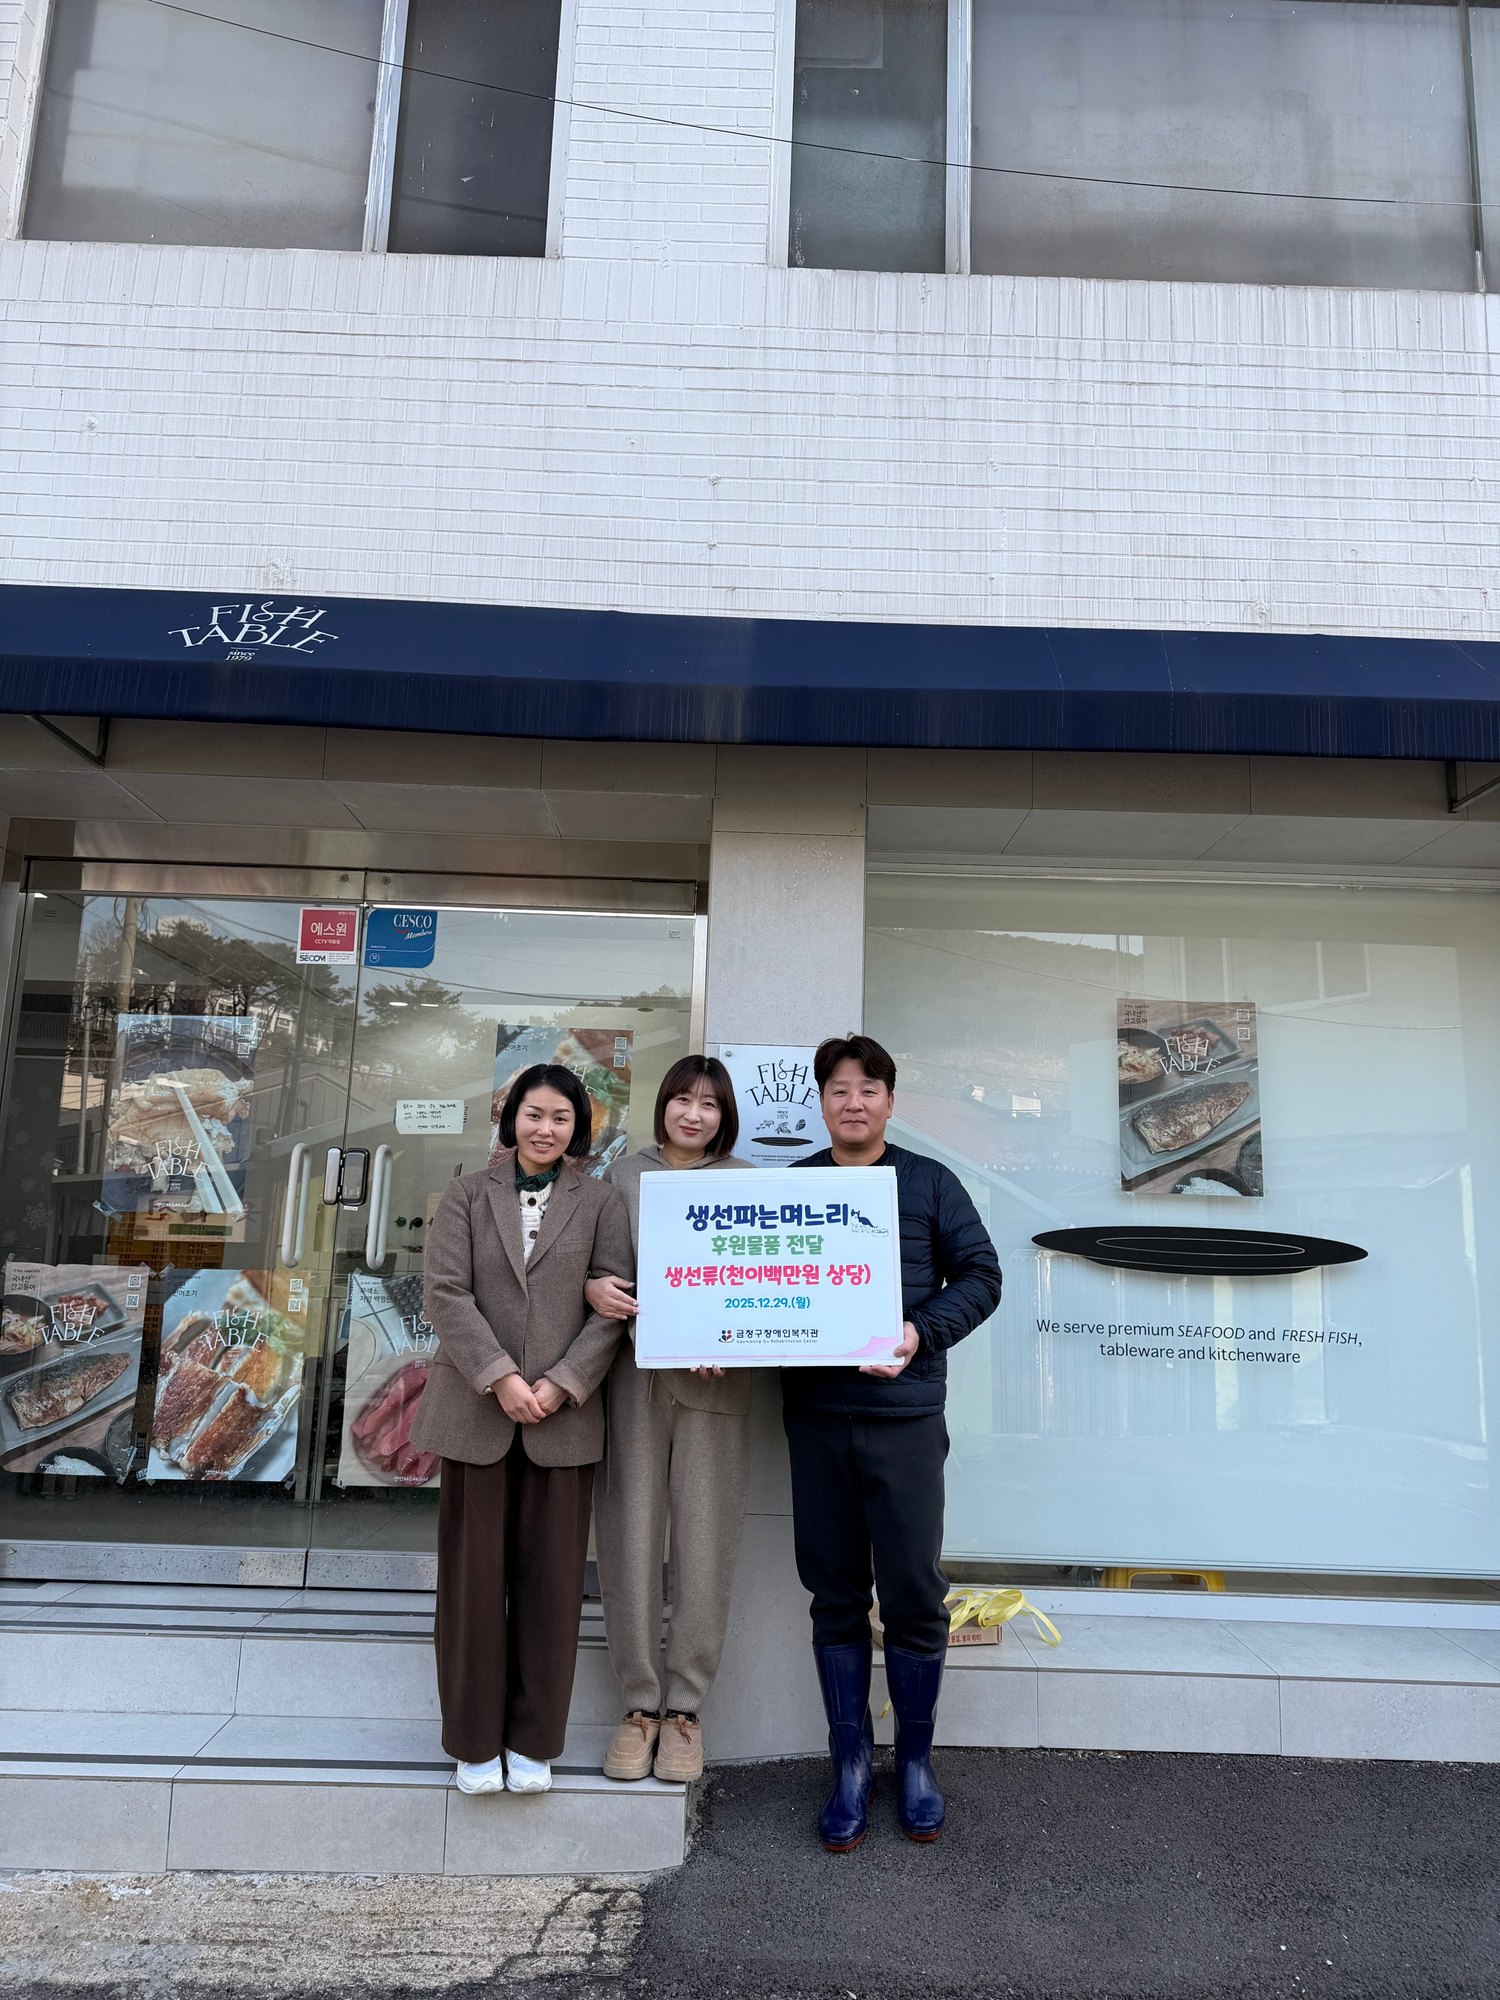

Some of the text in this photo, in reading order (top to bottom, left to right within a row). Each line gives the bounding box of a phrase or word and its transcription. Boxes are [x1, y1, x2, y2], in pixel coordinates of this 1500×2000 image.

[208, 601, 327, 629] FISH
[167, 623, 340, 654] TABLE
[310, 922, 347, 936] 에스원
[393, 913, 432, 929] CESCO
[1163, 1033, 1209, 1056] FISH
[757, 1059, 809, 1085] FISH
[1154, 1054, 1221, 1077] TABLE
[745, 1082, 820, 1110] TABLE
[155, 1136, 202, 1160] FISH
[685, 1203, 849, 1231] 생선파는며느리
[711, 1234, 824, 1256] 후원물품 전달
[11, 1283, 36, 1291] 간고등어
[12, 1274, 31, 1283] 국내산
[664, 1263, 872, 1288] 생선류(천이백만원 상당)
[50, 1300, 97, 1325] FISH
[724, 1296, 811, 1310] 2025.12.29.(월)
[213, 1305, 260, 1330] FISH
[36, 1322, 105, 1347] TABLE
[200, 1328, 269, 1353] TABLE
[387, 1333, 437, 1357] TABL
[736, 1329, 819, 1339] 금정구장애인복지관
[1036, 1319, 1362, 1347] We serve premium SEAFOOD and FRESH FISH,
[1099, 1342, 1301, 1363] tableware and kitchenware
